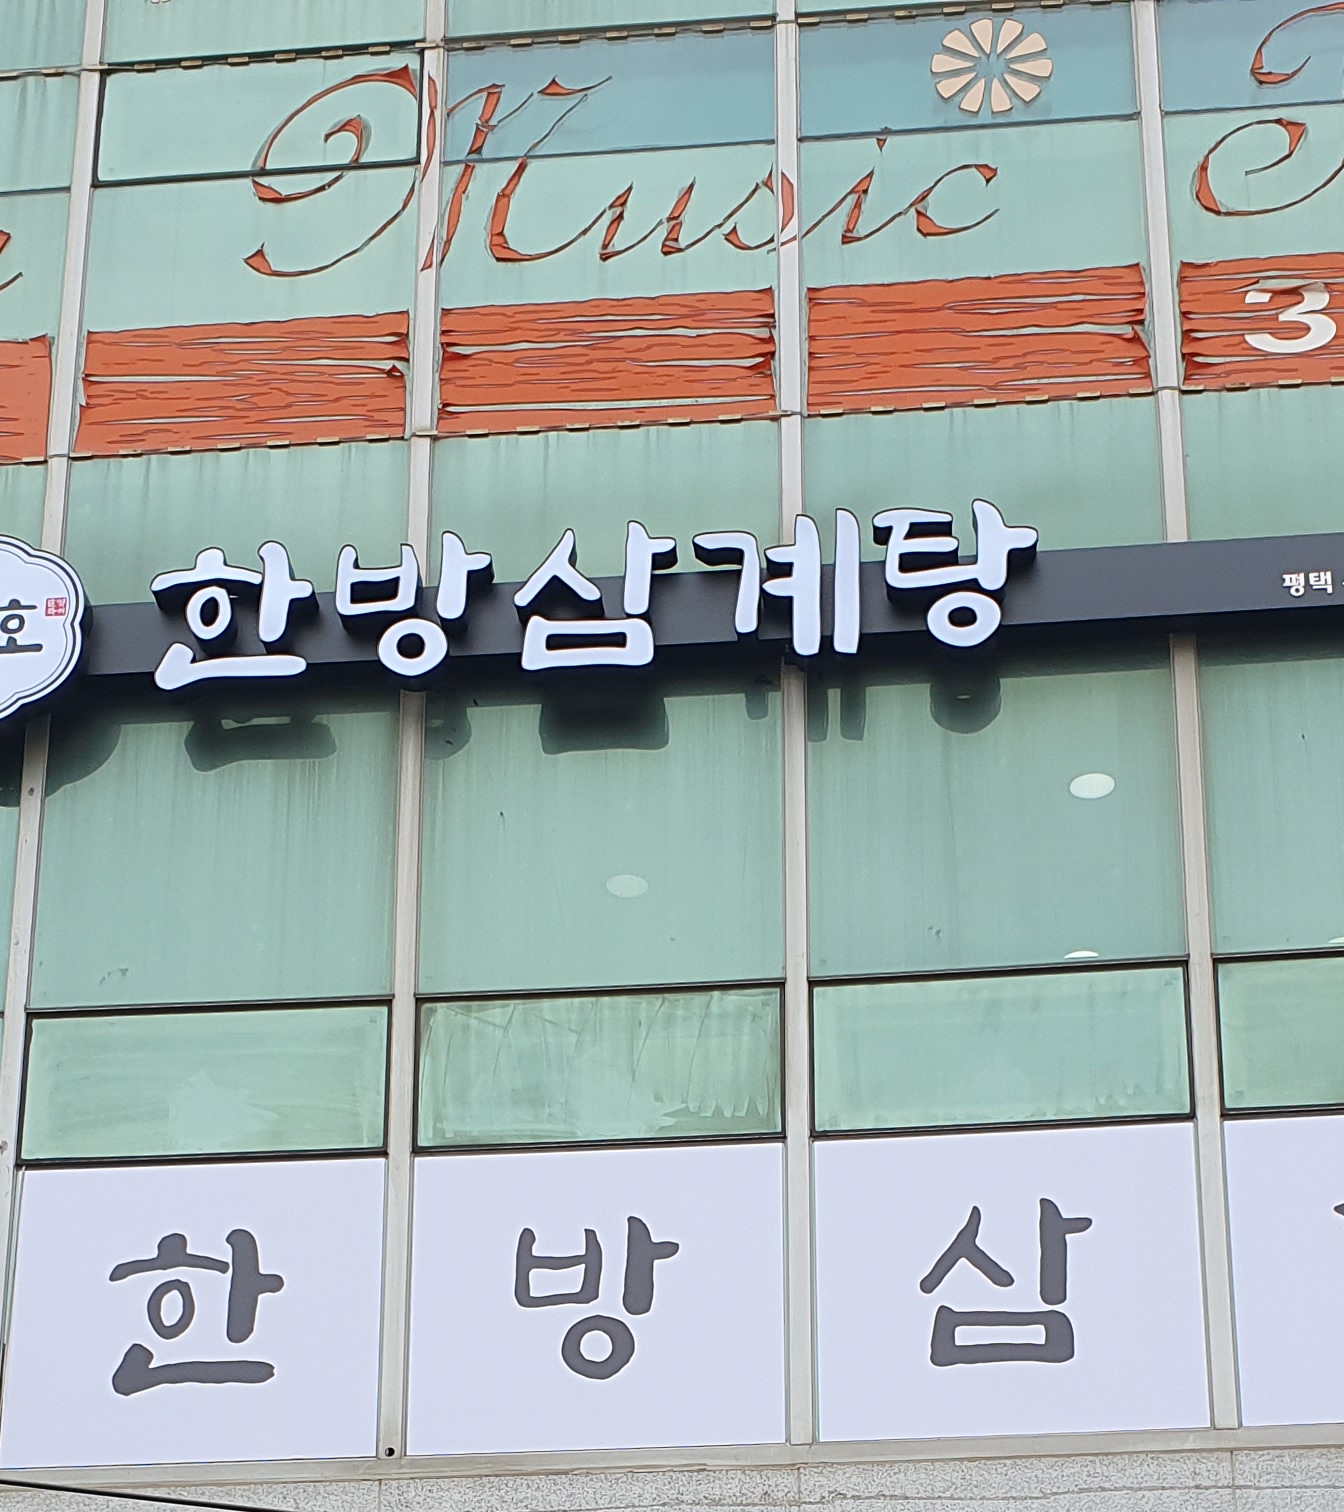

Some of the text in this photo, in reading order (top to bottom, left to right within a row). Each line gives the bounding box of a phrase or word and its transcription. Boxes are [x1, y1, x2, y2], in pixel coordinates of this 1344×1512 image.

[246, 62, 999, 278] Music
[154, 498, 1038, 692] 한방삼계탕
[1282, 571, 1333, 597] 평택
